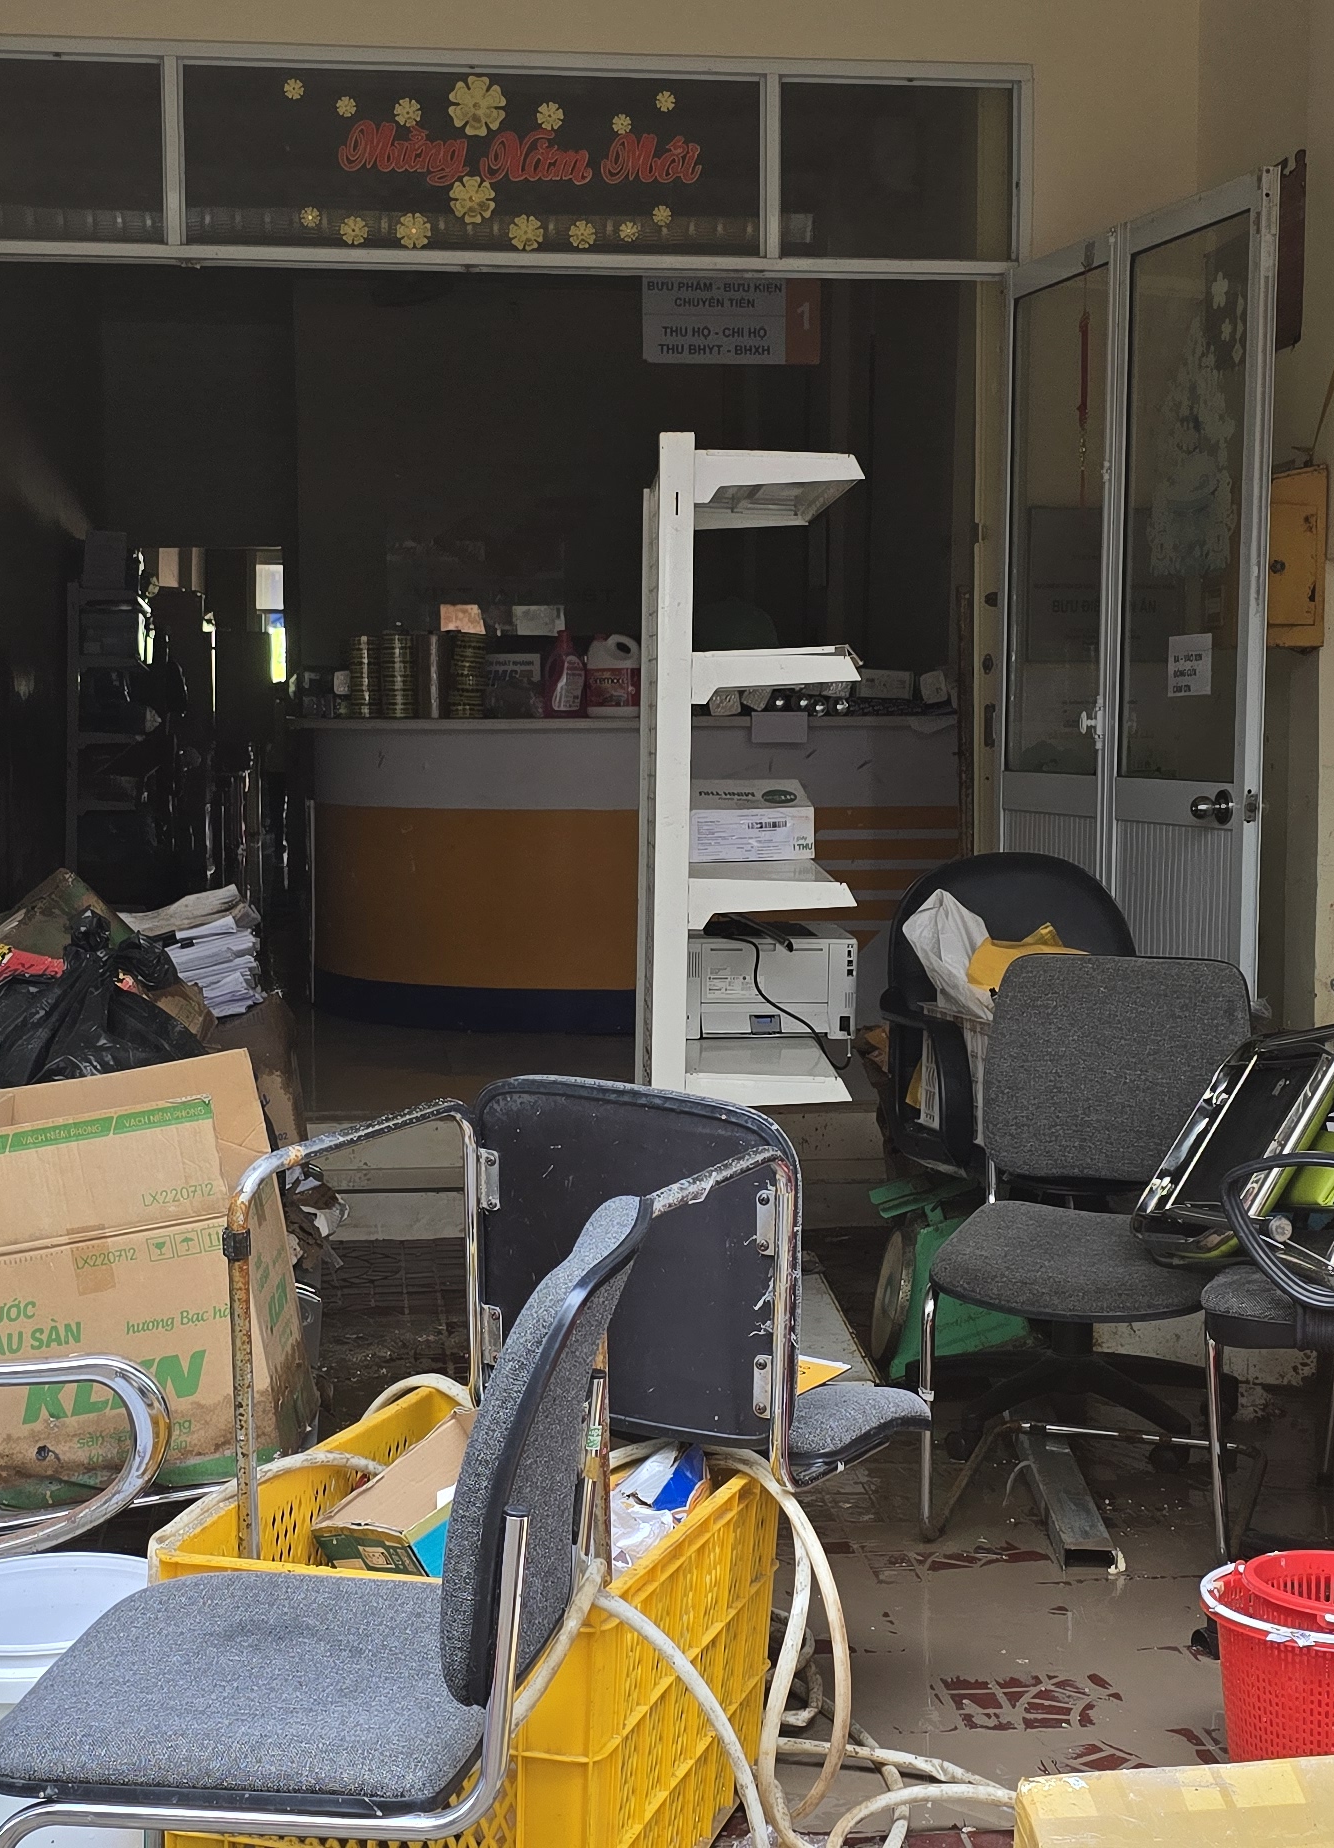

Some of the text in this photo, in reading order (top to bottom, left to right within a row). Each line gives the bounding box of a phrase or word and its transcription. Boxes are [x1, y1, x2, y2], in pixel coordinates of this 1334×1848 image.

[600, 133, 702, 184] Mới
[647, 280, 674, 291] BƯU
[723, 282, 751, 292] BƯU
[797, 302, 810, 330] 1
[661, 326, 688, 337] THU
[692, 325, 711, 340] HỘ
[722, 327, 744, 338] CHI
[748, 326, 767, 340] HỘ
[658, 344, 684, 355] THU
[688, 344, 723, 355] BHYT
[734, 345, 771, 355] BHXH
[141, 1182, 215, 1208] LX220712
[74, 1247, 138, 1270] LX220712
[126, 1315, 174, 1335] hương
[180, 1307, 209, 1327] Bạc
[30, 1318, 82, 1351] SÀN
